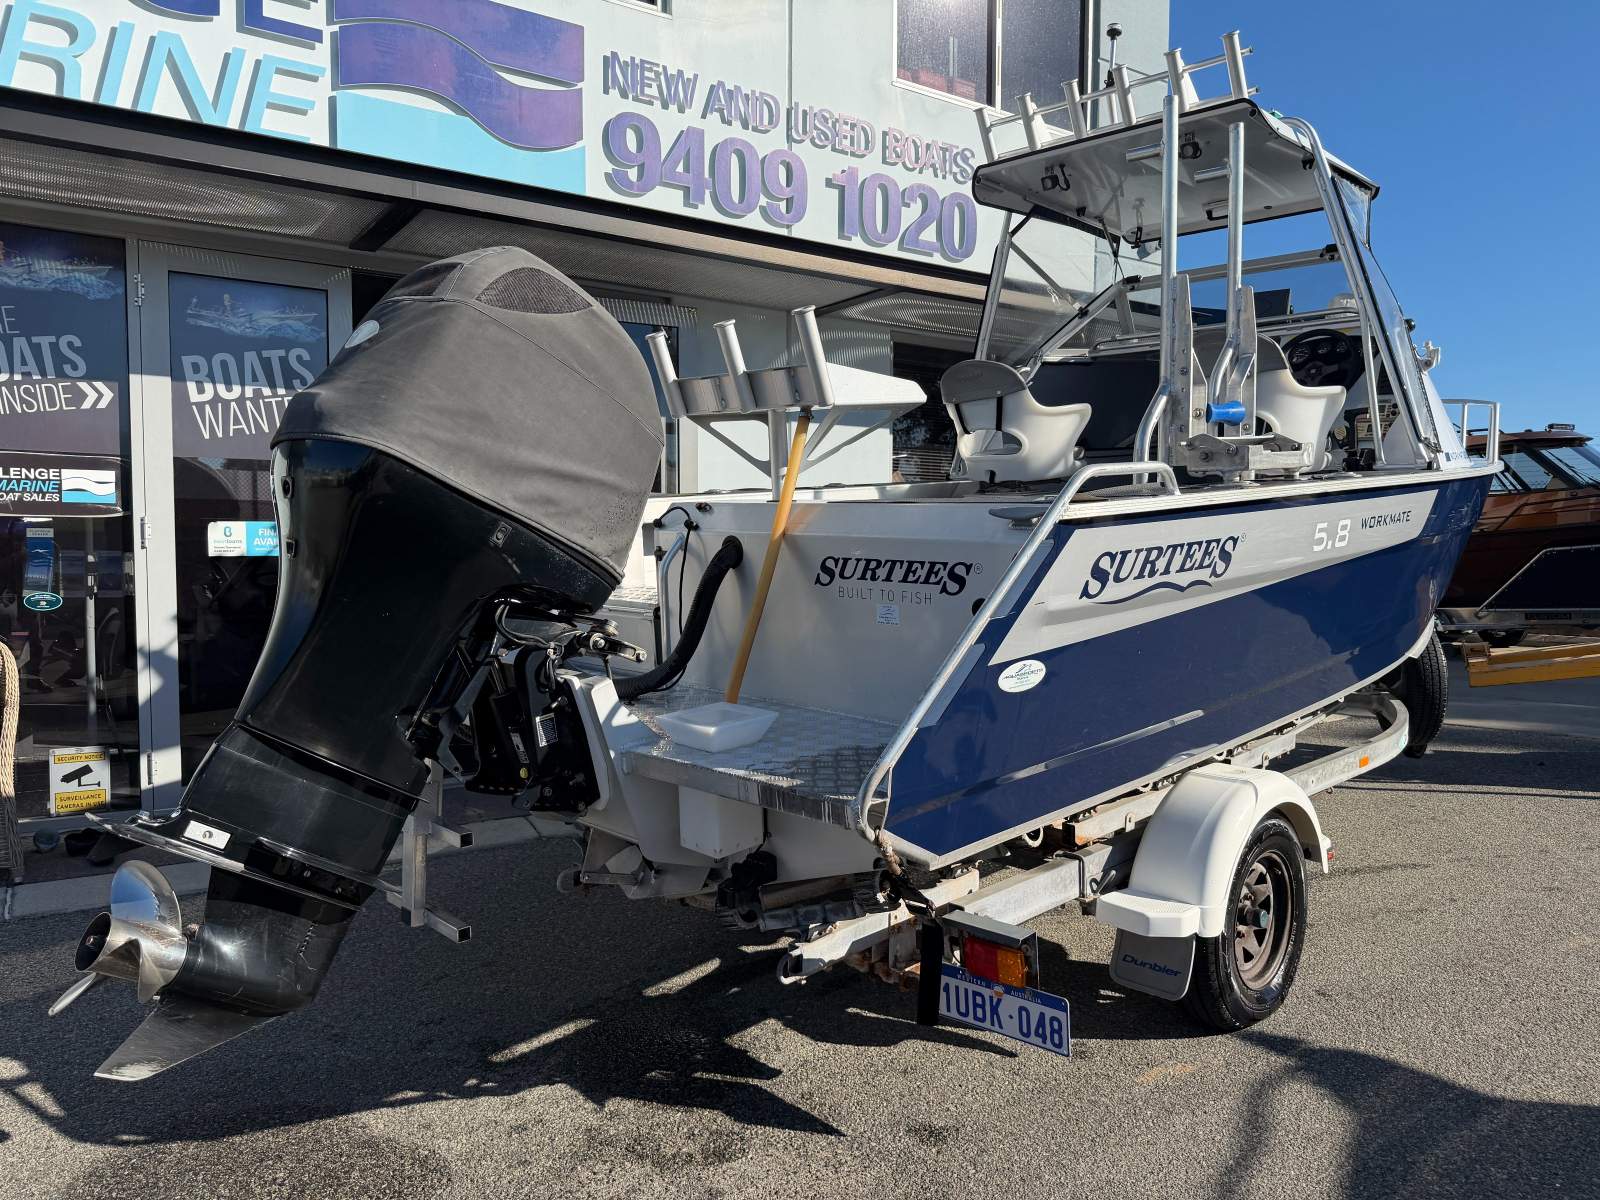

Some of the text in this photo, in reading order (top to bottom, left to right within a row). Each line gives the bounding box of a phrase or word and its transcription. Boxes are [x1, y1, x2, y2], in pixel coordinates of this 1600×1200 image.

[605, 51, 976, 185] NEW AND USED BOATS
[606, 111, 977, 261] 9409 1020
[181, 347, 315, 403] BOATS
[191, 396, 293, 440] WANT
[23, 493, 60, 502] SALES
[1312, 510, 1412, 552] 5.8 WORKMATE
[814, 555, 974, 597] SURTEES
[1078, 535, 1241, 600] SURTEES
[838, 586, 932, 606] BUILT TO FISH
[57, 755, 83, 763] SECURITY
[59, 793, 102, 802] SURVEILLANCE
[1122, 953, 1182, 977] Dunbier
